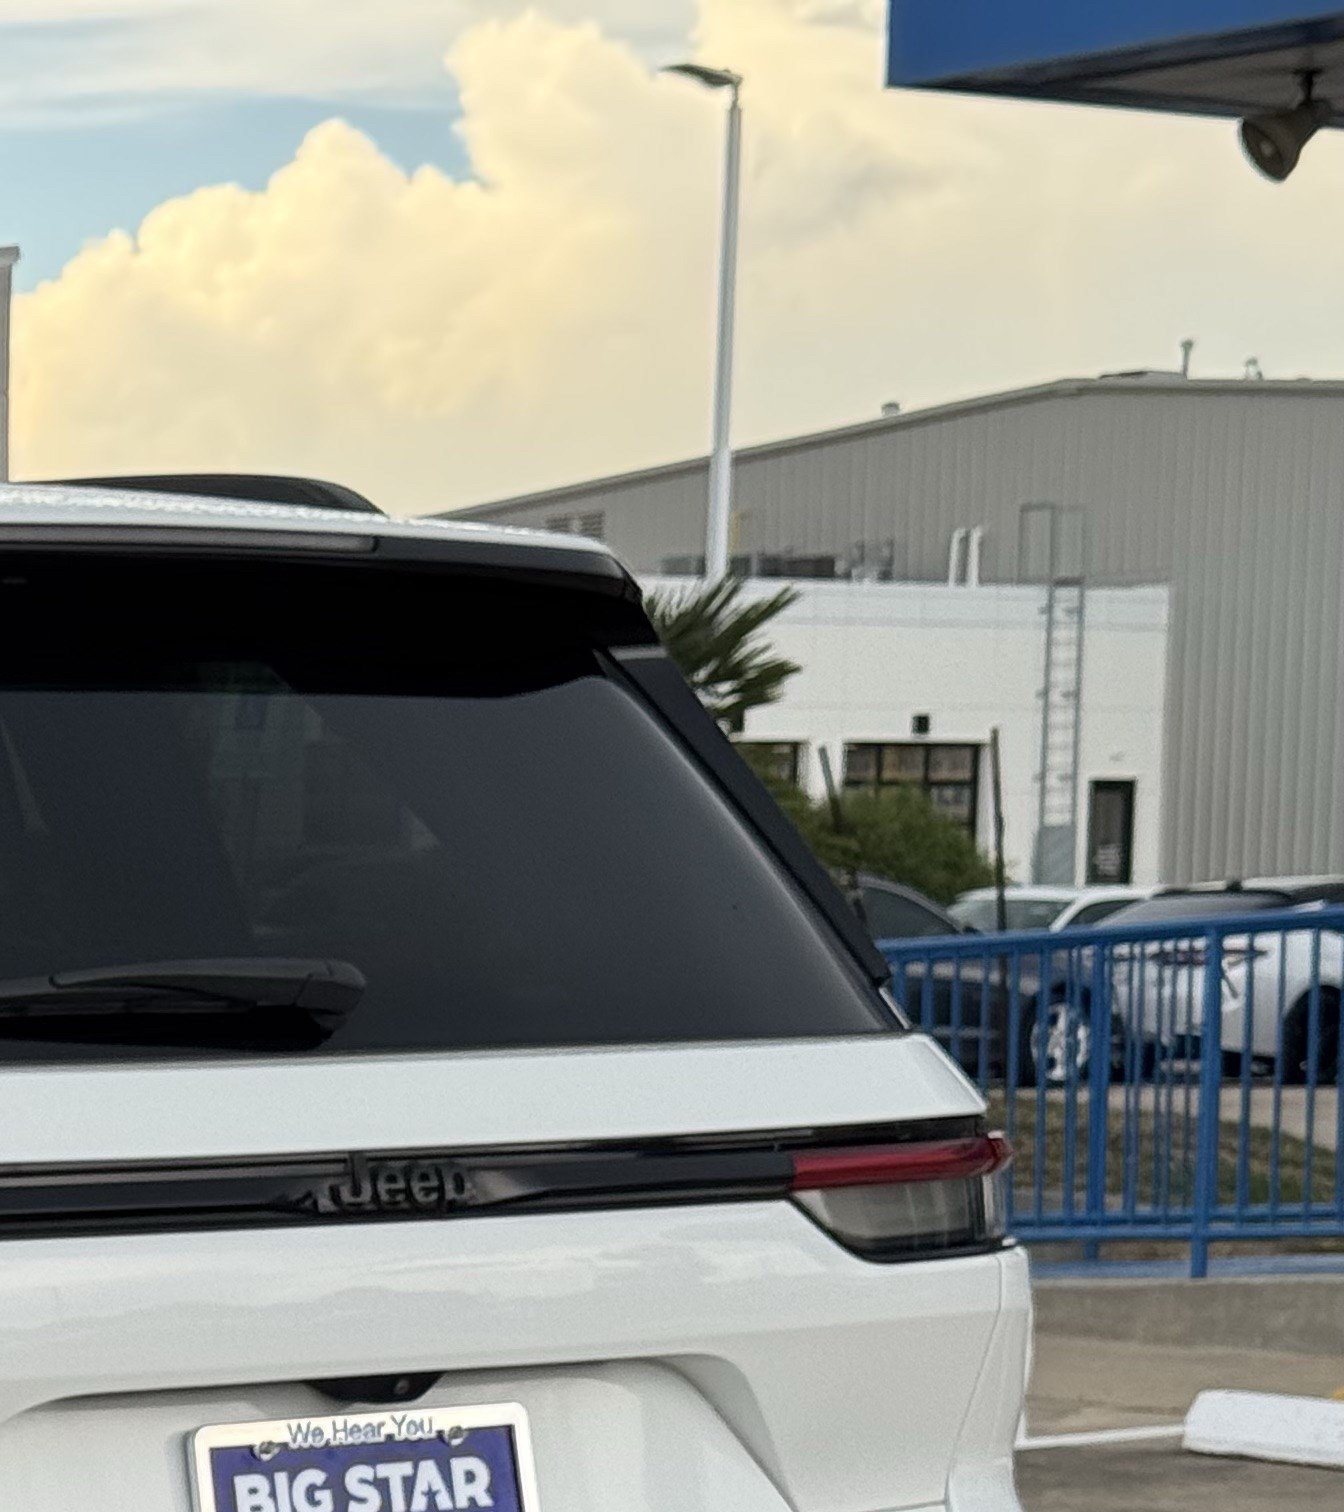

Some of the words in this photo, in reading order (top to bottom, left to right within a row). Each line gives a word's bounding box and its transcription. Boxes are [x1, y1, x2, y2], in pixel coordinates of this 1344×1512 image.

[334, 1152, 467, 1215] Jeep
[286, 1421, 324, 1446] We
[332, 1418, 386, 1441] Hear
[391, 1414, 434, 1437] You
